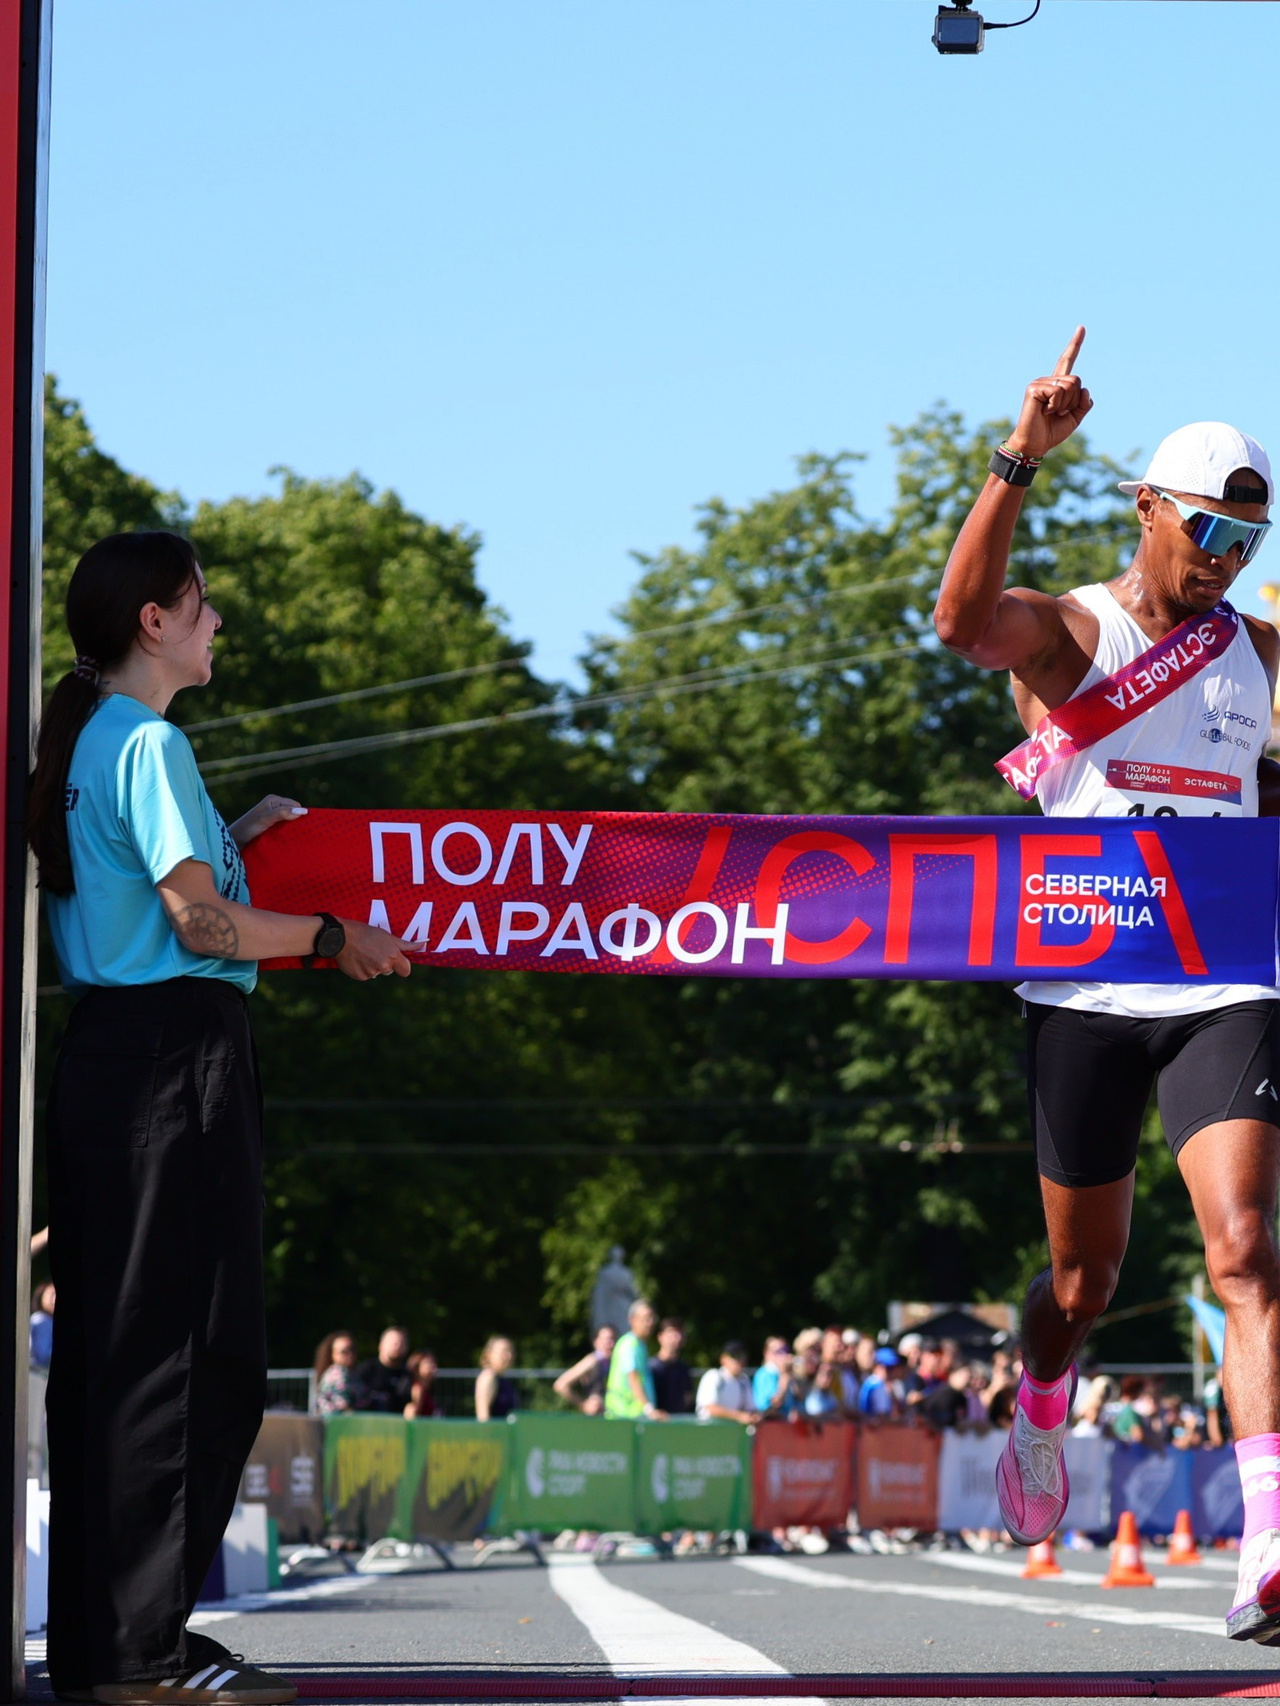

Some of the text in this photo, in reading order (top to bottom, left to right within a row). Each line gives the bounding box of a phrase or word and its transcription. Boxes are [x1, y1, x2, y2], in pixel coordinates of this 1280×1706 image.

[1104, 622, 1217, 711] ЭСТАФЕТА
[1125, 772, 1171, 784] МАРАФОН
[1127, 764, 1151, 774] ПОЛУ
[1184, 777, 1228, 791] ЭСТАФЕТА
[368, 821, 594, 886] ПОЛУ
[1025, 874, 1167, 898] СЕВЕРНАЯ
[1023, 903, 1155, 929] СТОЛИЦА
[367, 898, 790, 966] МАРАФОН
